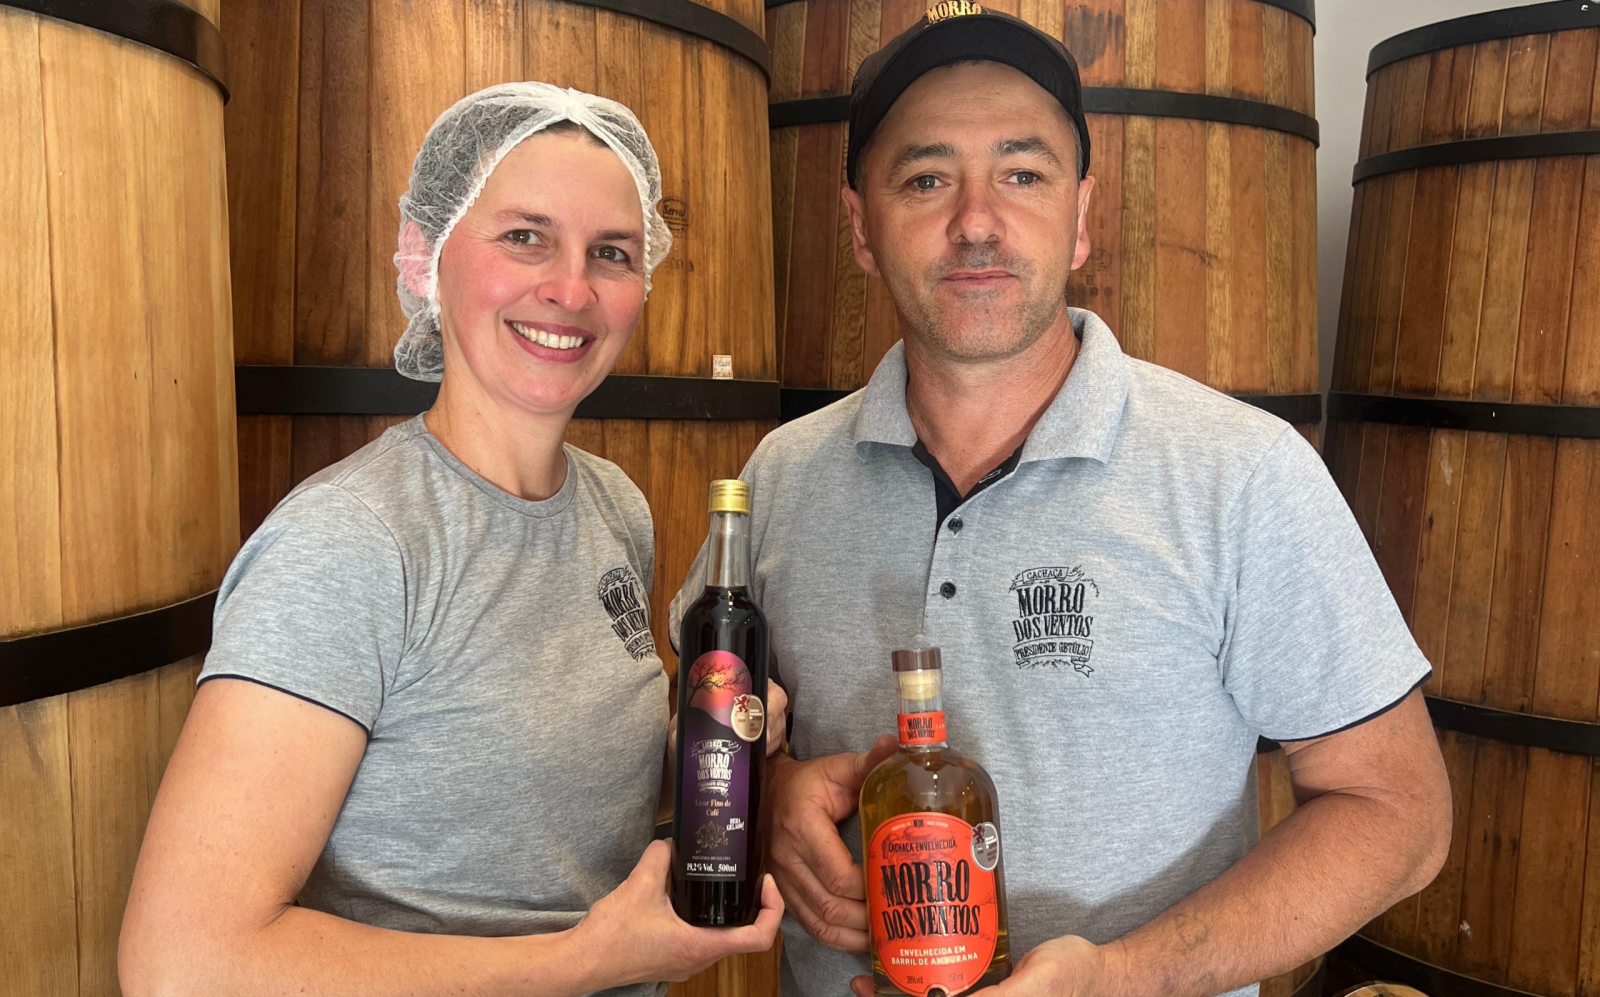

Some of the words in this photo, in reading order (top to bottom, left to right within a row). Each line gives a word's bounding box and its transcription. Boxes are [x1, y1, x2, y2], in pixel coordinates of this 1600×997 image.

[1026, 569, 1063, 580] CACHAÇA
[1016, 583, 1085, 618] MORRO
[1012, 616, 1041, 642] DOS
[1043, 614, 1093, 638] VENTOS
[1014, 641, 1057, 660] PRESIDENTE
[906, 717, 933, 730] MORRO
[698, 753, 730, 769] MORRO
[710, 799, 724, 807] Fino
[724, 799, 732, 807] de
[706, 808, 720, 817] Café
[916, 838, 957, 851] ENVELHECIDA
[718, 863, 737, 873] 500ml
[881, 859, 970, 908] MORRO
[882, 906, 916, 941] DOS
[916, 904, 981, 937] VENTOS
[899, 946, 953, 957] ENVELHECIDA
[954, 945, 966, 954] EM
[891, 957, 917, 966] BARRIL
[918, 957, 929, 966] DE
[931, 952, 979, 966] AMBURANA
